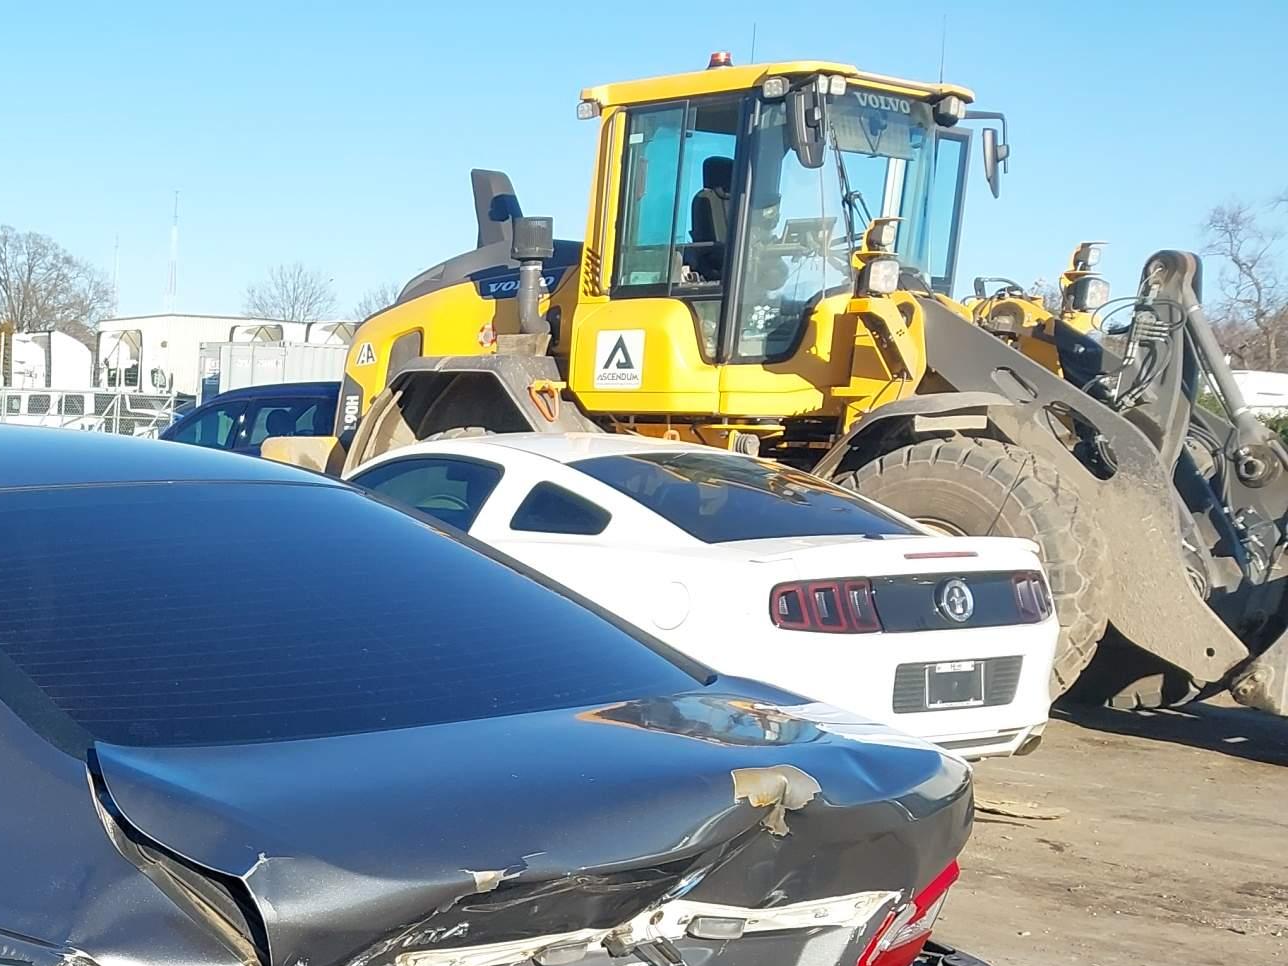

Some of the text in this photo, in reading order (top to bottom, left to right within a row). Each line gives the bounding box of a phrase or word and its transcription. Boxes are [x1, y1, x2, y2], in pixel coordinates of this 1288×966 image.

[853, 91, 911, 114] VOLVO
[597, 372, 640, 382] ASCENDUM
[343, 395, 360, 431] L90H
